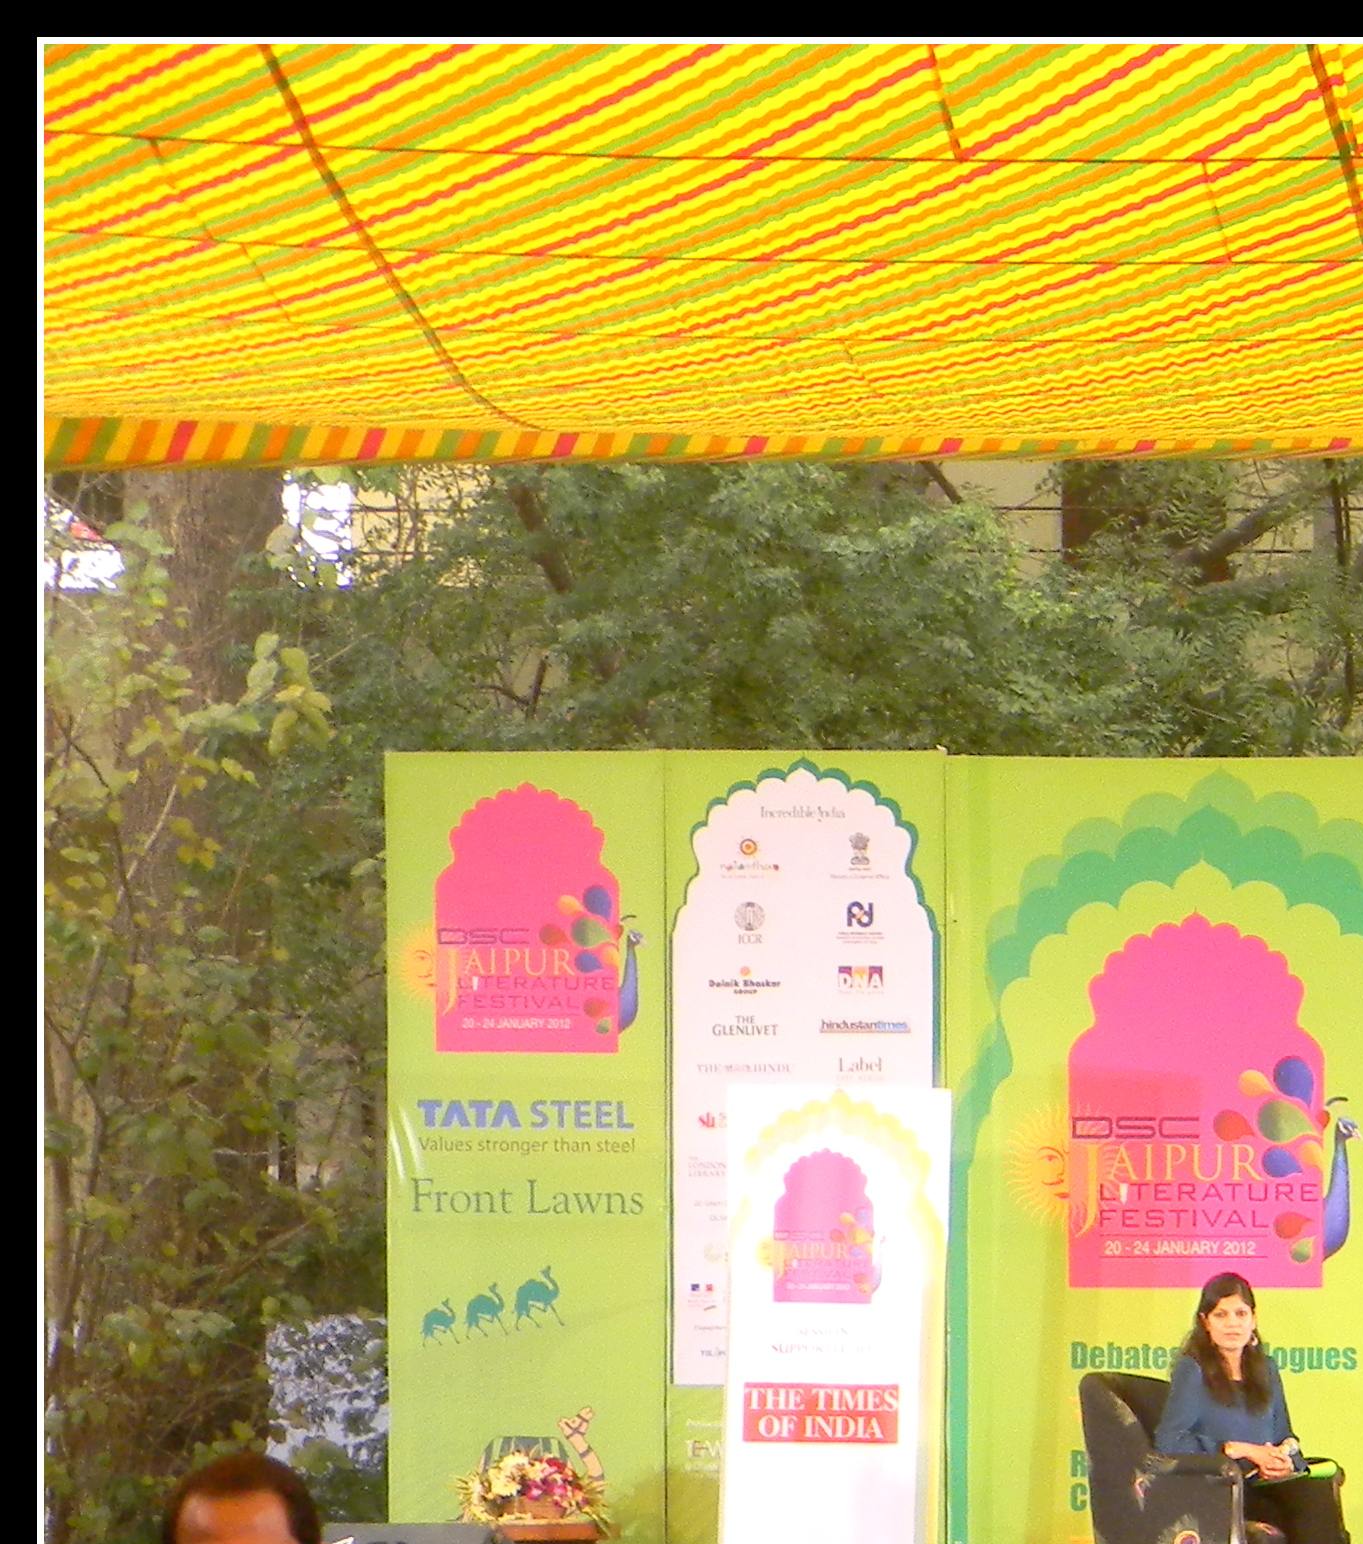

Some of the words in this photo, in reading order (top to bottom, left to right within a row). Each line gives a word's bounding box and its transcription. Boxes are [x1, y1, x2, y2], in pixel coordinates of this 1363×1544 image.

[437, 928, 530, 945] DSC
[737, 933, 763, 945] ICCR
[442, 947, 575, 1016] JAIPUR
[459, 976, 615, 992] LITERATURE
[743, 979, 781, 988] Bhaskar
[838, 972, 883, 989] DNA
[459, 995, 581, 1010] FESTIVAL
[462, 1018, 475, 1029] 20
[484, 1018, 495, 1029] 24
[497, 1018, 544, 1030] JANUARY
[547, 1018, 571, 1029] 2012
[735, 1015, 755, 1025] THE
[712, 1024, 779, 1036] GLENLIVET
[838, 1056, 883, 1073] Label
[417, 1099, 522, 1129] TATA
[530, 1099, 635, 1131] STEEL
[1072, 1116, 1200, 1140] DSC
[419, 1137, 472, 1152] Values
[478, 1138, 548, 1155] stronger
[553, 1137, 590, 1153] than
[596, 1138, 636, 1153] steel
[411, 1178, 512, 1214] Front
[525, 1178, 645, 1215] Lawns
[1074, 1143, 1266, 1238] JAIPUR
[1099, 1182, 1320, 1204] LITERATURE
[1100, 1208, 1271, 1229] FESTIVAL
[1104, 1240, 1122, 1255] 20
[1132, 1240, 1151, 1255] 24
[1153, 1240, 1220, 1256] JANUARY
[1222, 1240, 1257, 1256] 2012
[745, 1388, 806, 1411] THE
[811, 1388, 899, 1412] TIMES
[758, 1415, 797, 1438] OF
[803, 1415, 885, 1439] INDIA
